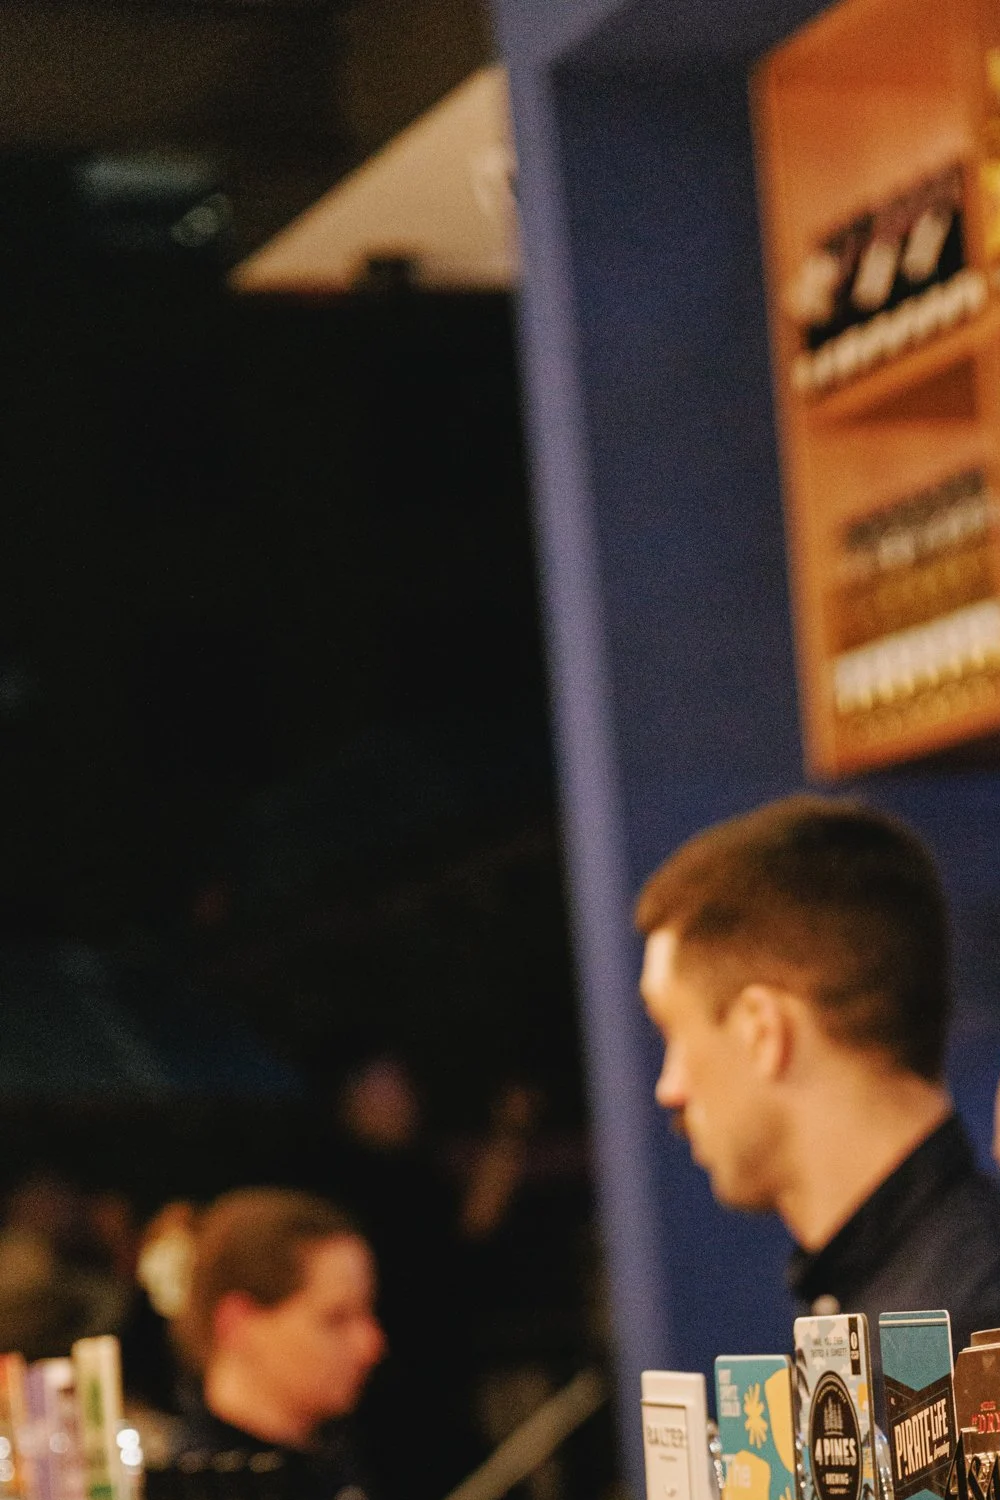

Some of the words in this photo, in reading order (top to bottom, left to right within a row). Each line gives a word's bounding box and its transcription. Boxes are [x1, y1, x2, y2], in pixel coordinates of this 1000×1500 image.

[815, 1437, 823, 1466] 4
[823, 1437, 857, 1466] PINES
[721, 1454, 751, 1488] The
